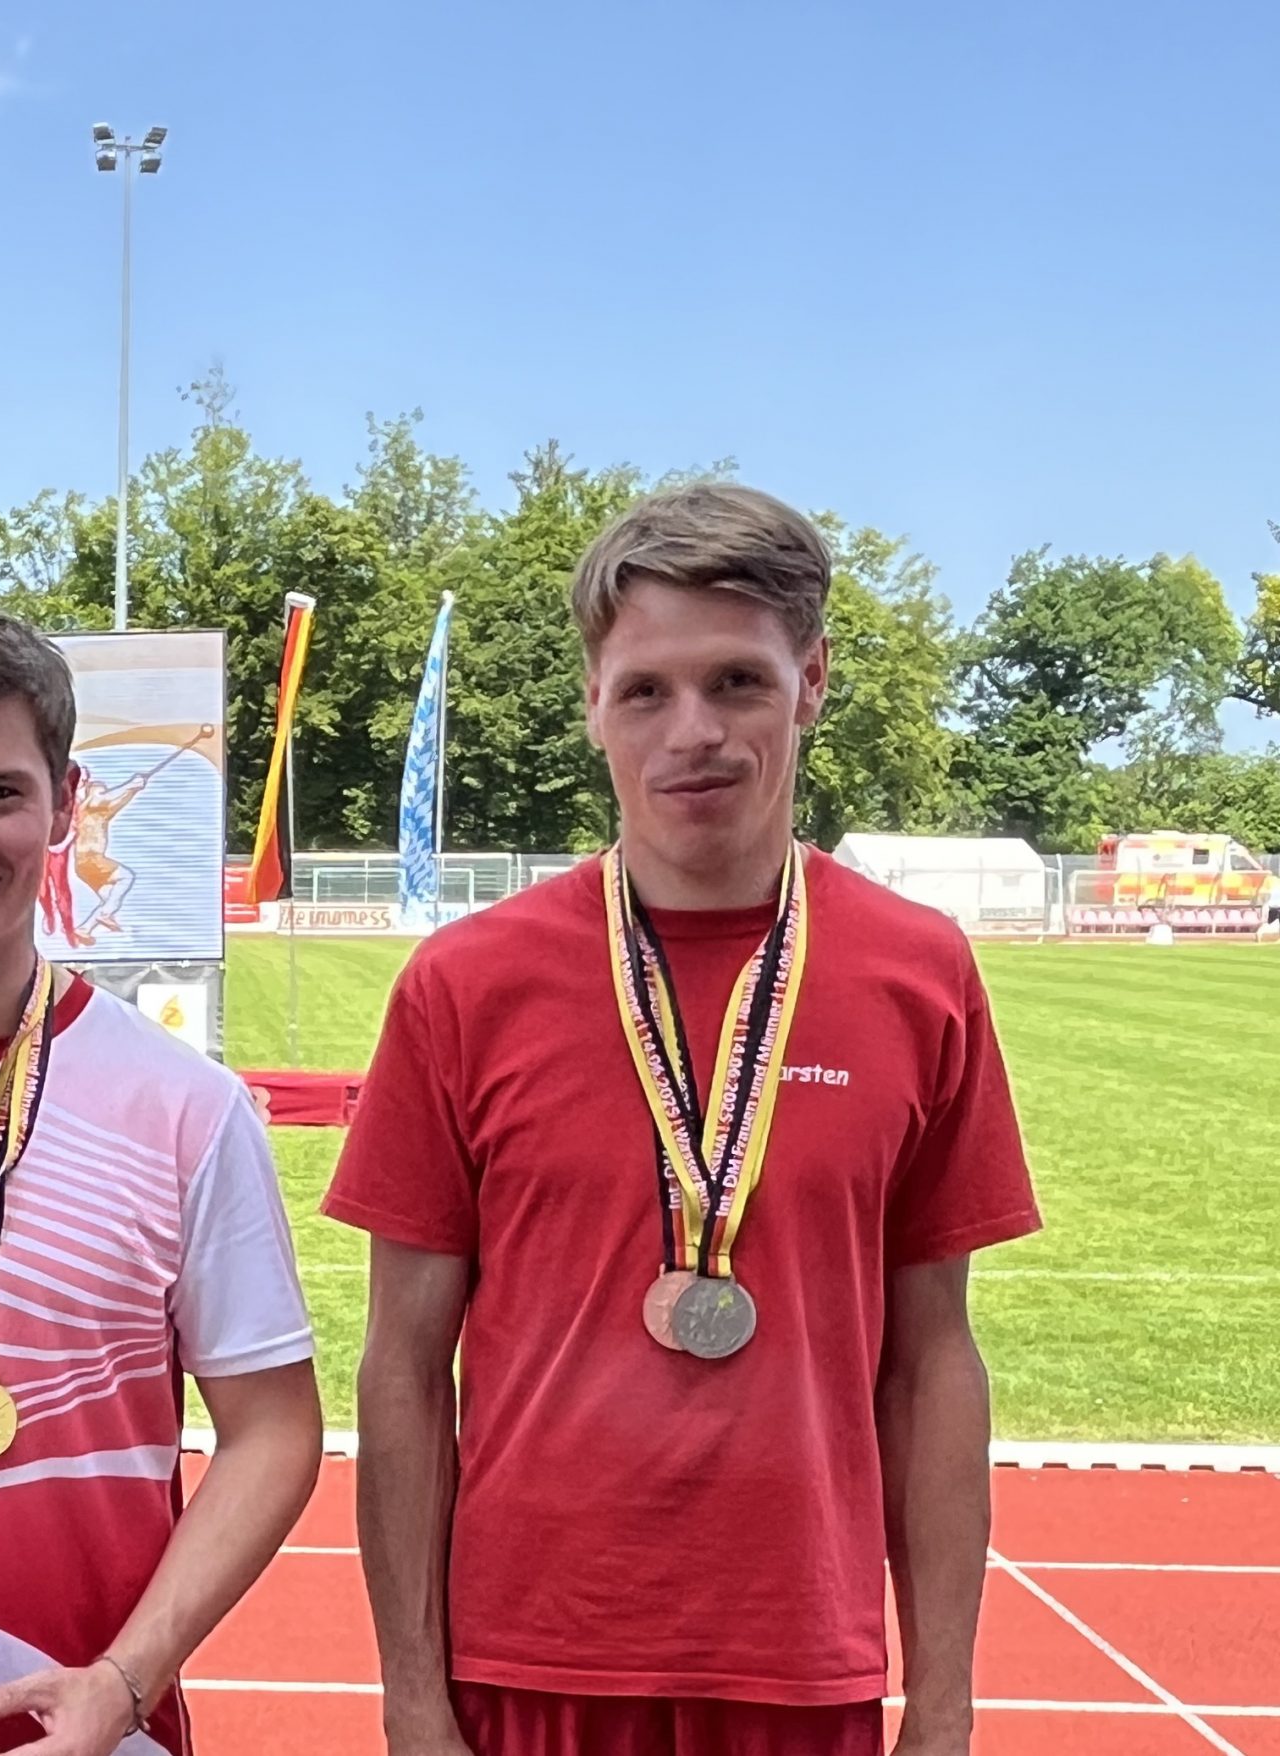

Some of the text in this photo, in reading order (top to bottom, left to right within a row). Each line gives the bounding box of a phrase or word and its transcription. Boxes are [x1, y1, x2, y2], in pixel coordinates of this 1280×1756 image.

[757, 1001, 781, 1062] Männer
[640, 1033, 681, 1118] 14.06.2025
[721, 1037, 746, 1123] 14.06.2025
[749, 1065, 767, 1097] und
[779, 1064, 849, 1086] arsten
[733, 1100, 757, 1157] Frauen
[723, 1158, 740, 1188] DM
